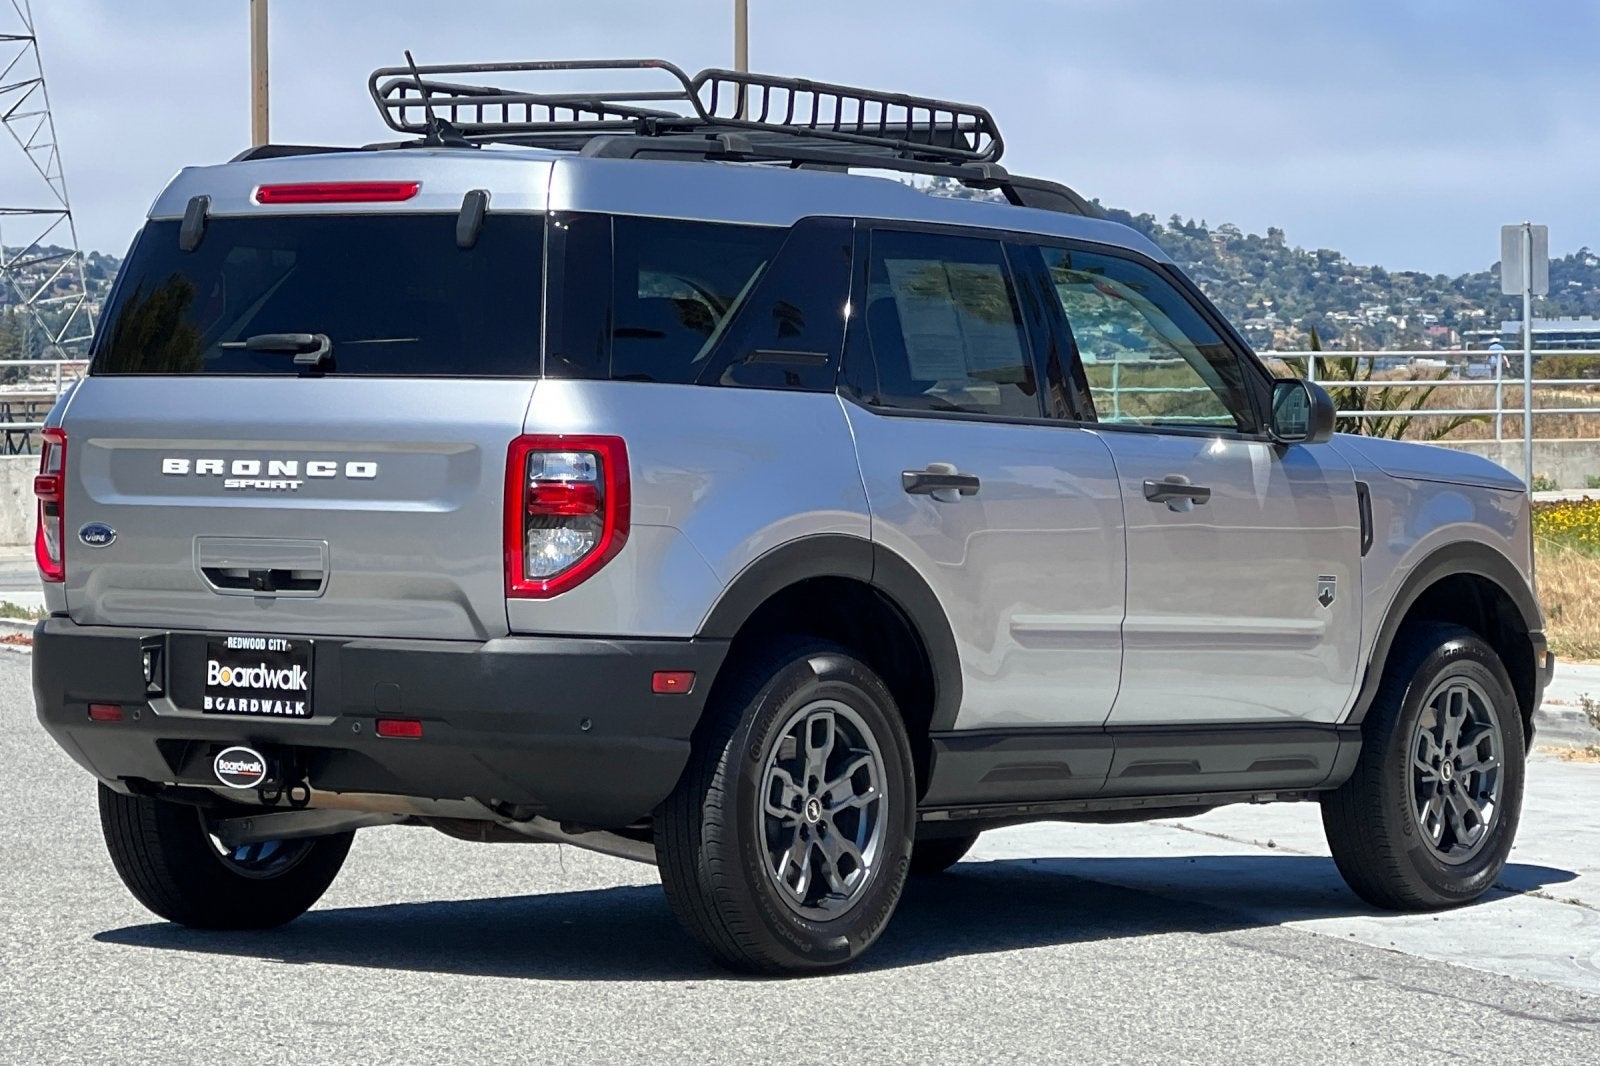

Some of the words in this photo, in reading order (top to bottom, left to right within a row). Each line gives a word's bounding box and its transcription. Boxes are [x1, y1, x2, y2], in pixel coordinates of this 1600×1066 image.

[162, 458, 378, 478] BRONCO
[224, 478, 304, 490] SPORT
[227, 636, 266, 650] REDWOOD
[268, 638, 288, 652] CITY
[207, 660, 308, 691] Boardwalk
[204, 696, 305, 715] BOARDWALK
[219, 759, 262, 772] Boardwalk
